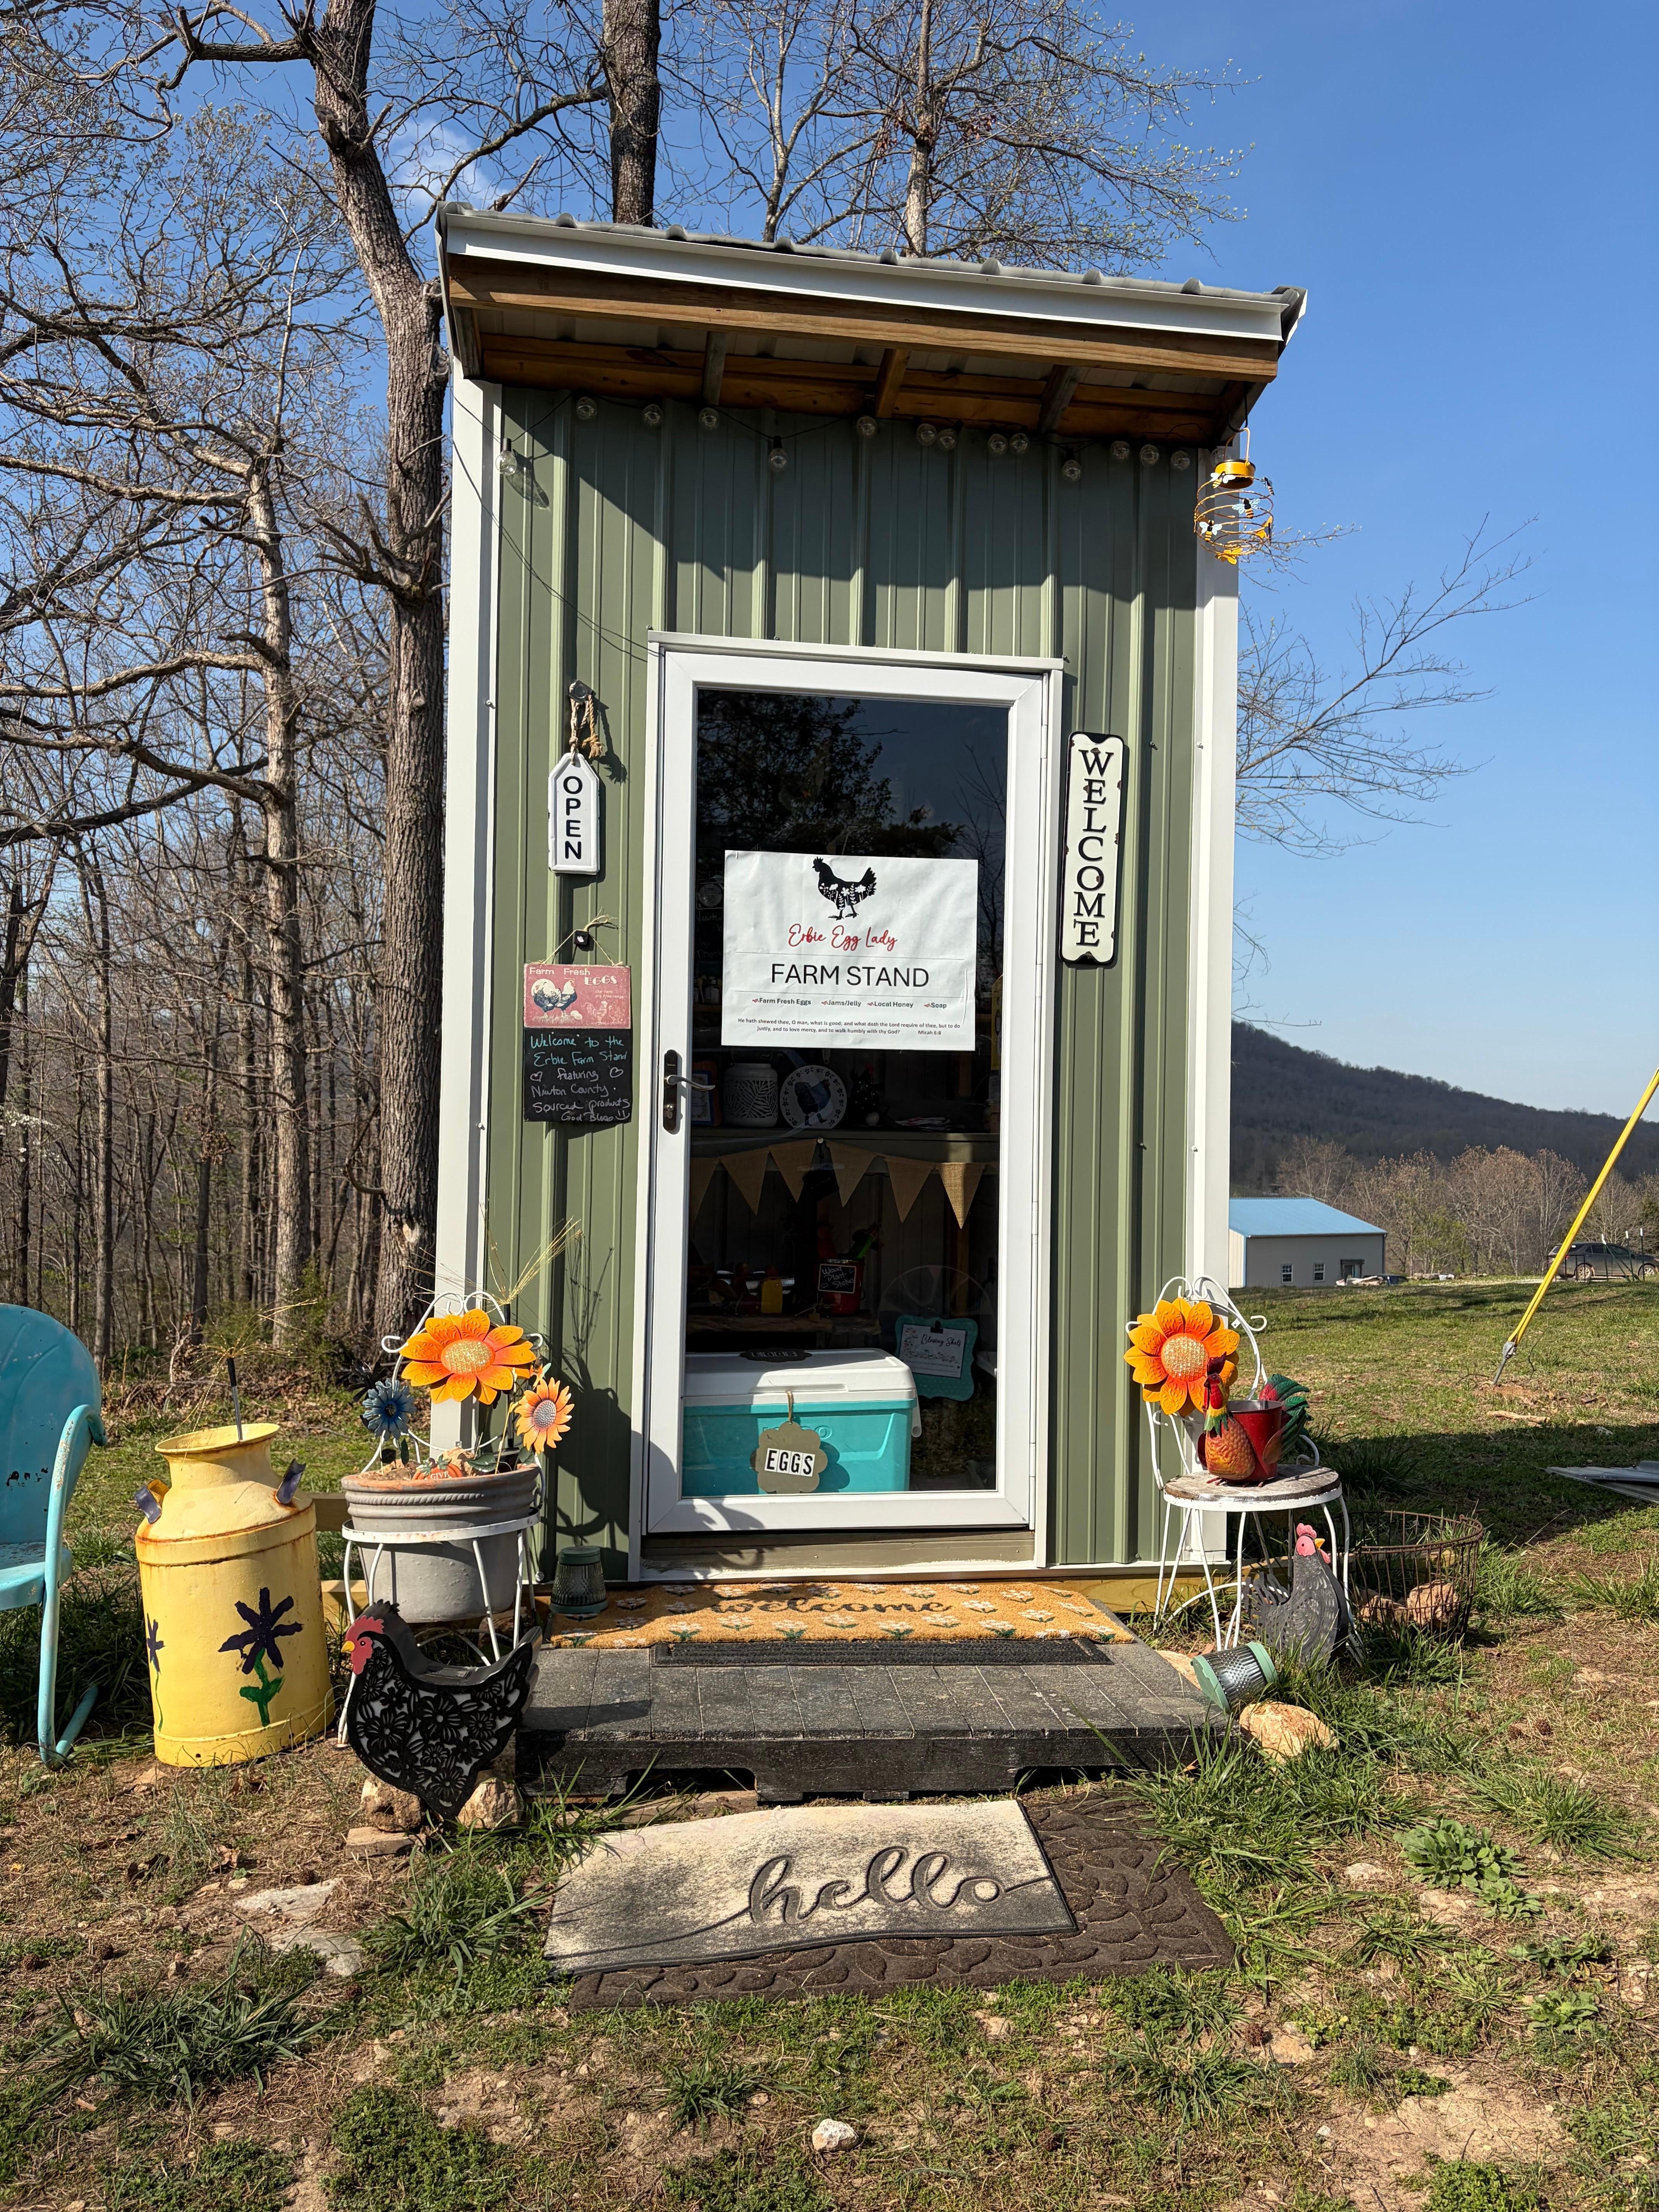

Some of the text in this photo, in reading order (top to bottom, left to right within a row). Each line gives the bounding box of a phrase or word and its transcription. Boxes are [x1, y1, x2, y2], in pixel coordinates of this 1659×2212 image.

[563, 776, 583, 860] OPEN
[1073, 749, 1114, 947] WELCOME
[788, 923, 898, 951] Erbie Egg Lady
[564, 968, 591, 976] Fresh
[771, 963, 929, 987] FARM STAND
[584, 975, 617, 986] EGGS
[531, 1034, 624, 1049] Welcome to the
[534, 1050, 627, 1067] Erbie Farm Stand
[531, 1084, 608, 1098] Newton County
[561, 1111, 614, 1121] God Bless
[822, 1266, 842, 1274] Wood
[824, 1272, 847, 1282] Plant
[946, 1337, 961, 1347] Shelf
[766, 1450, 814, 1475] EGGS
[430, 1471, 450, 1479] GIVE
[711, 1597, 953, 1613] welcome
[749, 1846, 1005, 1924] hello
